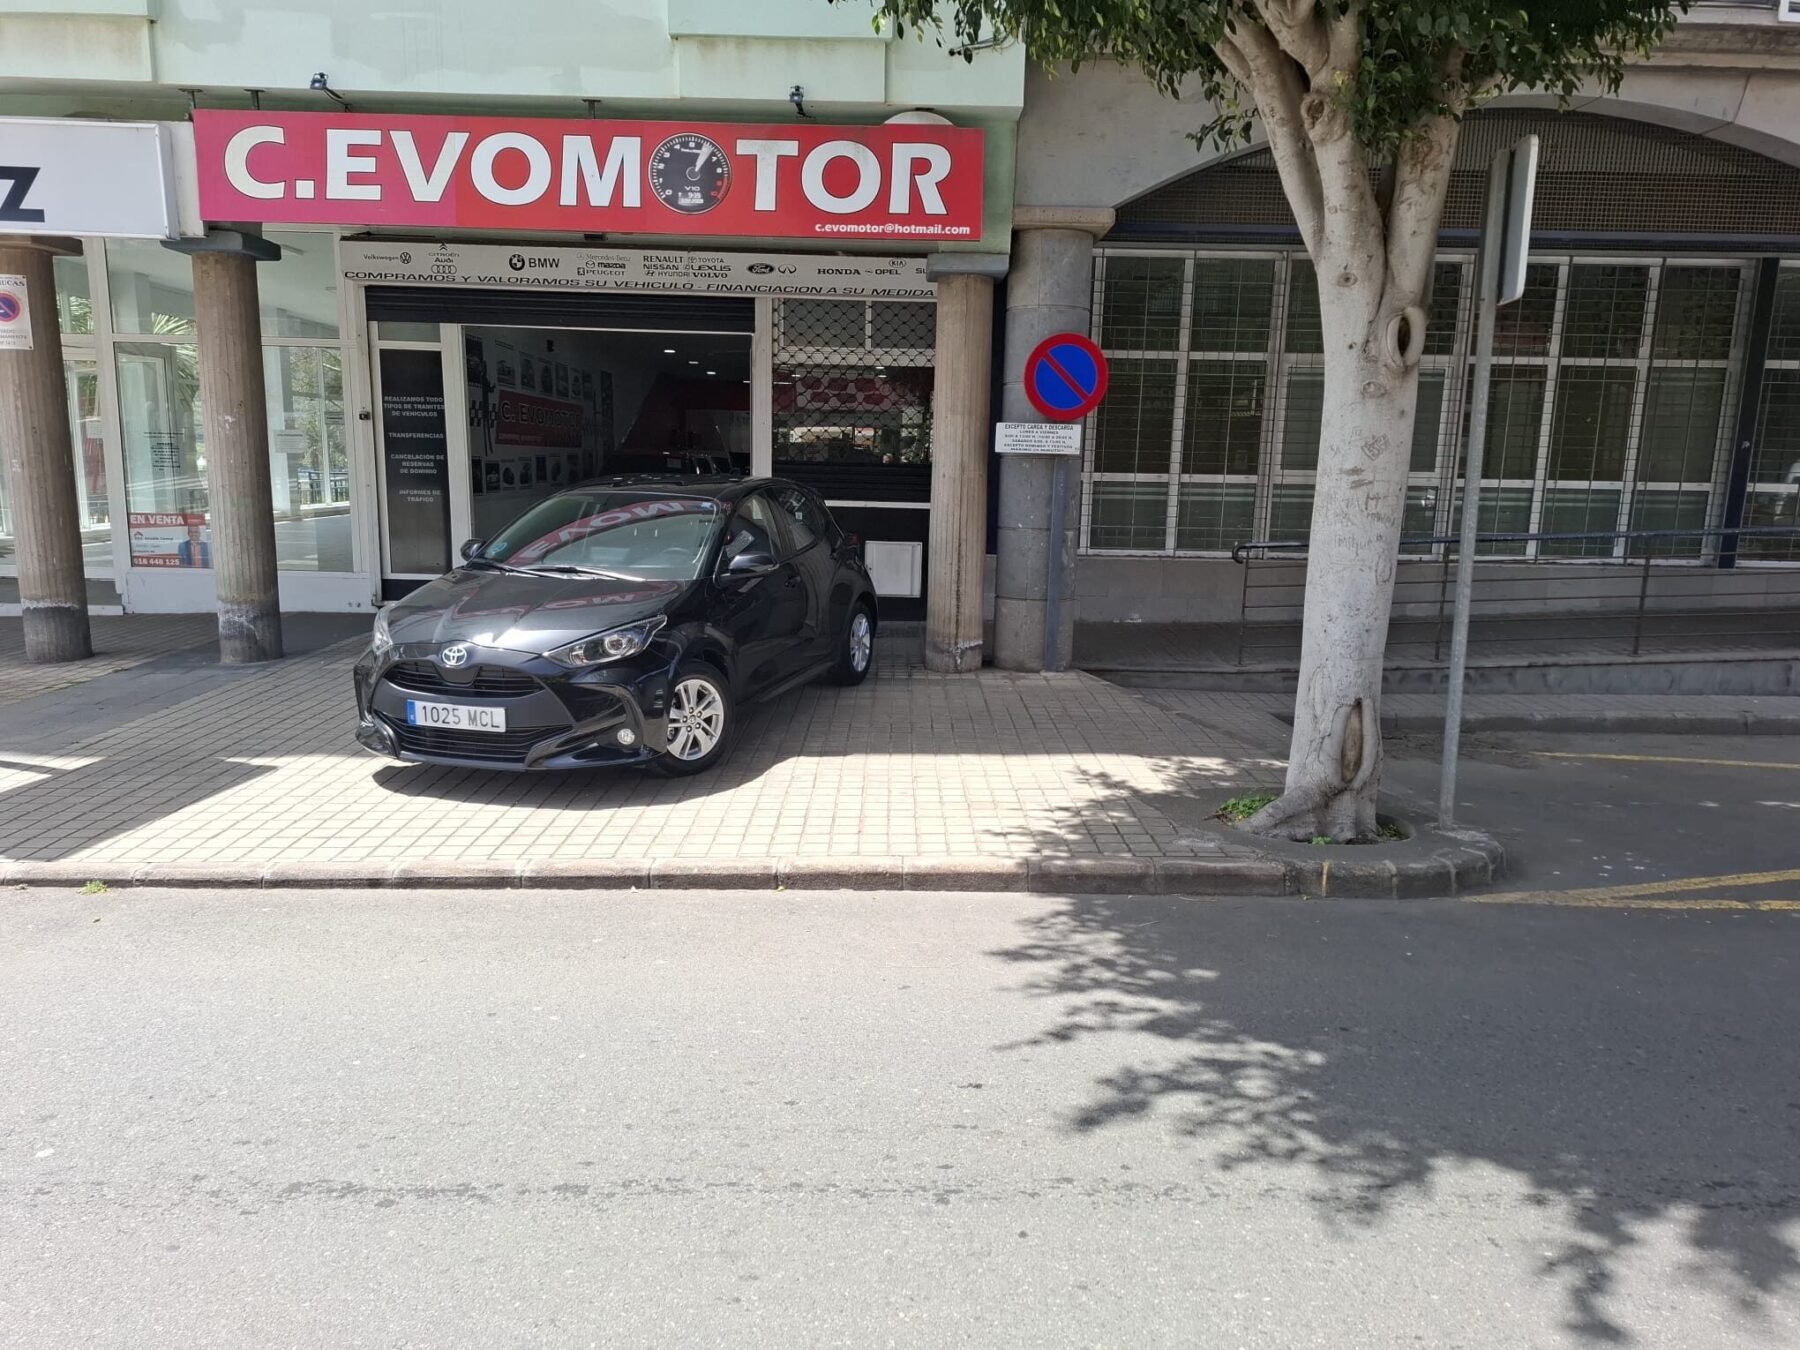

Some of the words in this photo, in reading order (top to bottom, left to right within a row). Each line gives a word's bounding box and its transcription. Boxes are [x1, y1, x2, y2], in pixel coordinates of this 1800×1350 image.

[815, 223, 970, 235] c.evomotor@hotmail.com
[528, 257, 560, 269] BMW
[643, 255, 684, 263] RENAULT
[690, 264, 731, 272] LEXUS
[817, 268, 861, 276] HONDA
[344, 271, 456, 282] COMPRAMOS
[461, 275, 471, 283] Y
[477, 275, 580, 286] VALORAMOS
[585, 279, 607, 287] SU
[614, 280, 694, 290] VEHICULO
[706, 283, 823, 294] FINANCIACION
[826, 286, 838, 294] A
[841, 287, 865, 295] SU
[871, 288, 934, 297] MEDIDA
[130, 515, 145, 524] EN
[148, 515, 184, 525] VENTA
[421, 704, 461, 724] 1025
[467, 708, 500, 728] MCL
